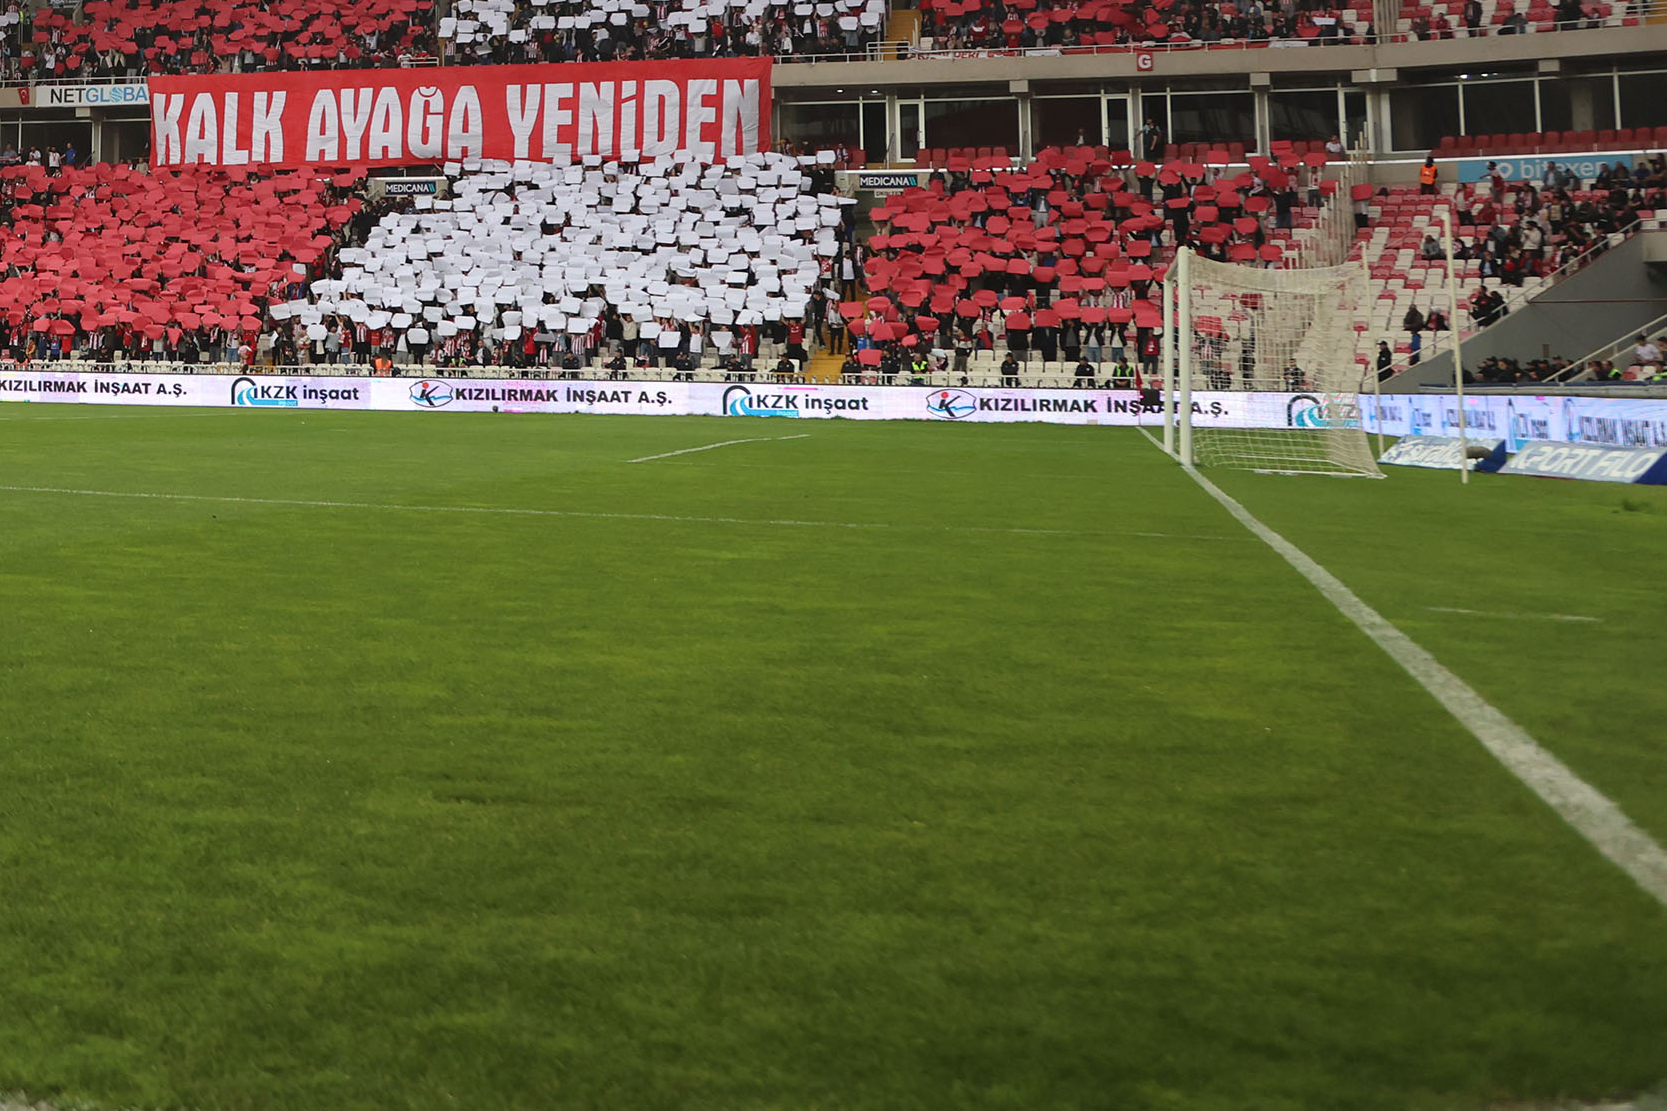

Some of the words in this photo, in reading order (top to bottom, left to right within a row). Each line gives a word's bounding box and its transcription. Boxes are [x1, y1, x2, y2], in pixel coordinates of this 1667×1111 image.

[1137, 54, 1152, 69] G
[152, 89, 288, 166] KALK
[304, 85, 484, 161] AYAĞA
[385, 183, 430, 193] MEDICANA
[859, 176, 910, 186] MEDICANA
[94, 378, 152, 397] İNŞAAT
[302, 384, 360, 403] inşaat
[455, 388, 559, 403] KIZILIRMAK
[565, 386, 632, 405] İNŞAAT
[804, 393, 870, 414] inşaat
[979, 397, 1098, 414] KIZILIRMAK
